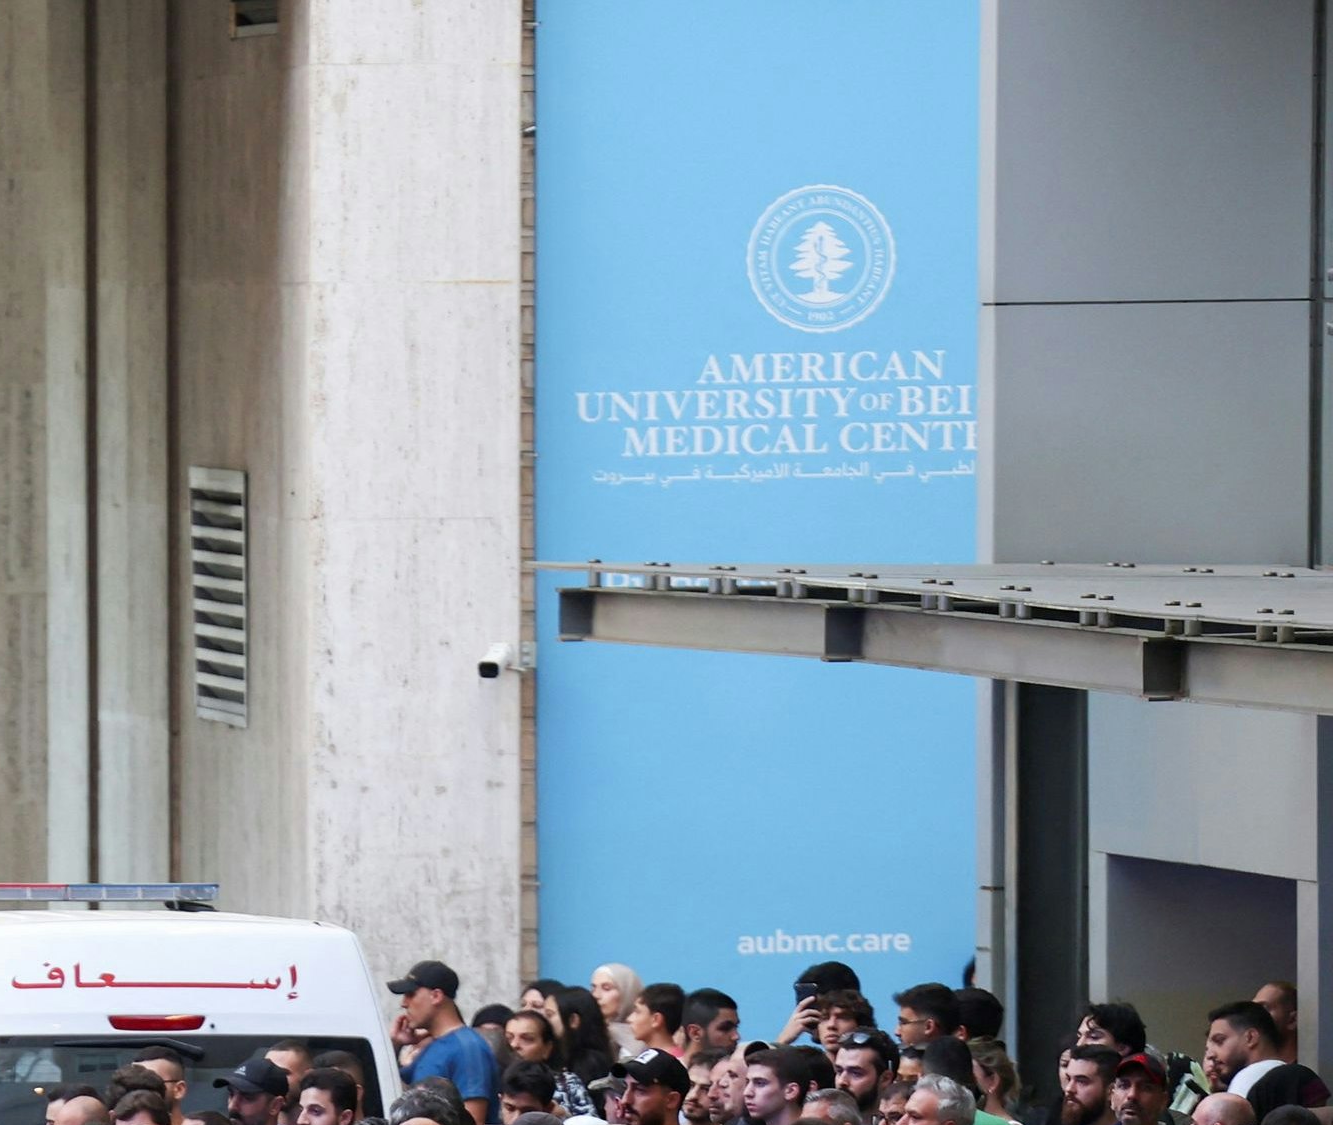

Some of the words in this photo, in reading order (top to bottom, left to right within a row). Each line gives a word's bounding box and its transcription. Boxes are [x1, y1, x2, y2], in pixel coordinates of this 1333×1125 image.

[696, 350, 947, 386] AMERICAN
[575, 385, 857, 422] UNIVERSITY
[859, 393, 896, 412] OF
[621, 423, 828, 457] MEDICAL
[592, 470, 656, 486] بيروت
[659, 465, 702, 488] في
[792, 461, 870, 481] الجامعة
[872, 461, 915, 483] في
[736, 929, 913, 954] aubmc.care
[11, 962, 299, 1000] إسعاف
